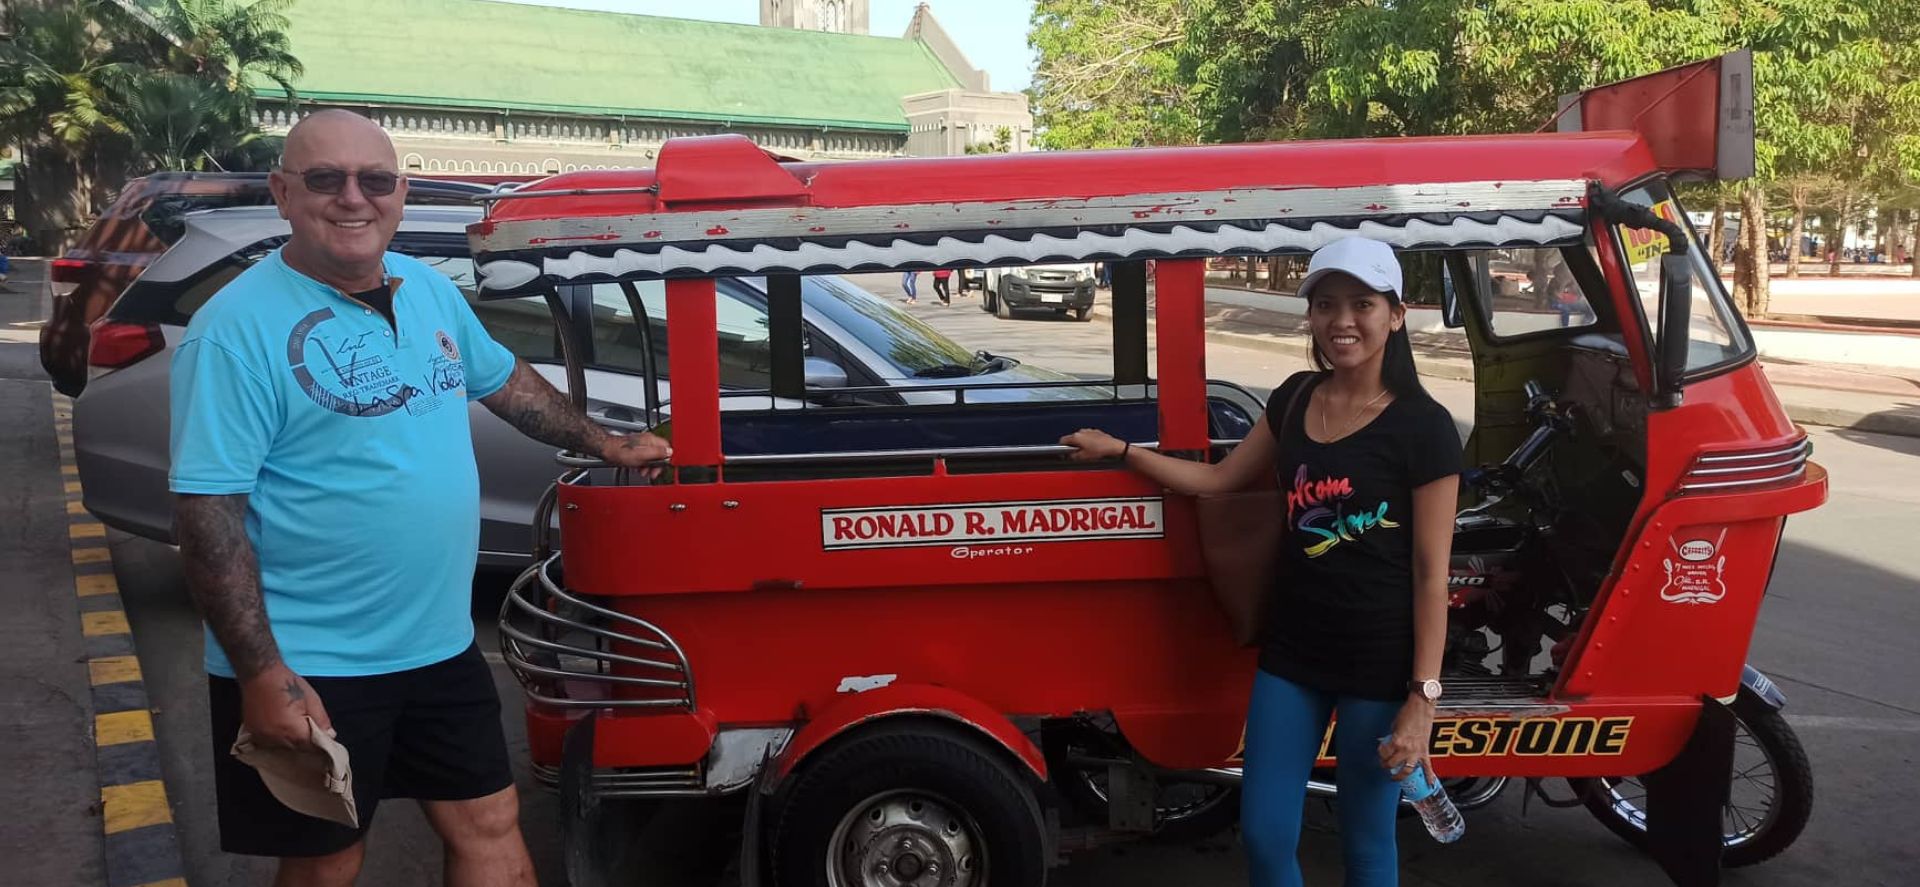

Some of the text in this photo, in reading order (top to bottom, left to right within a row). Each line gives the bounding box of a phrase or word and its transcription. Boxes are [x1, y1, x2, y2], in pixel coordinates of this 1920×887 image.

[832, 504, 1156, 540] RONALD R. MADRIGAL
[951, 546, 1033, 559] Operator
